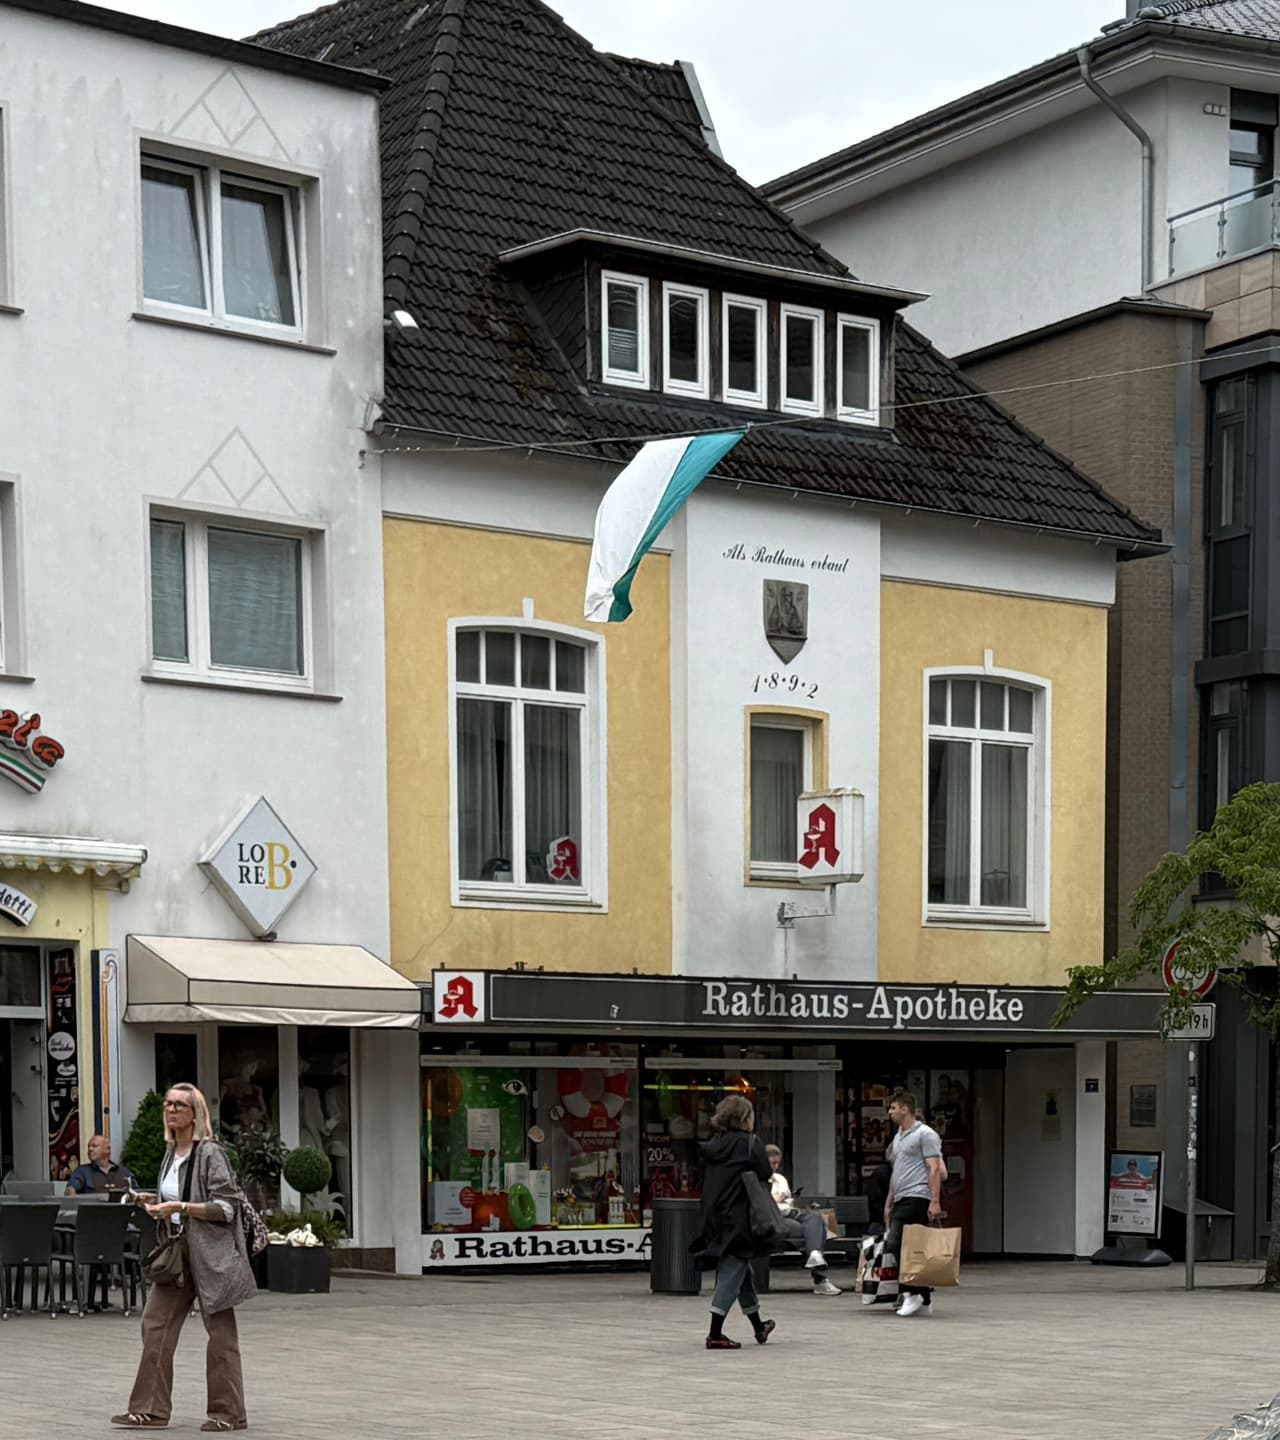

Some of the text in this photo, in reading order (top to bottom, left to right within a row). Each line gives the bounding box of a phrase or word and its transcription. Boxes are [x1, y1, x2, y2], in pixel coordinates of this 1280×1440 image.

[723, 543, 849, 572] Als Rathaus erbaut
[701, 981, 1024, 1029] Rathaus-Apotheke
[647, 1147, 675, 1161] 20%
